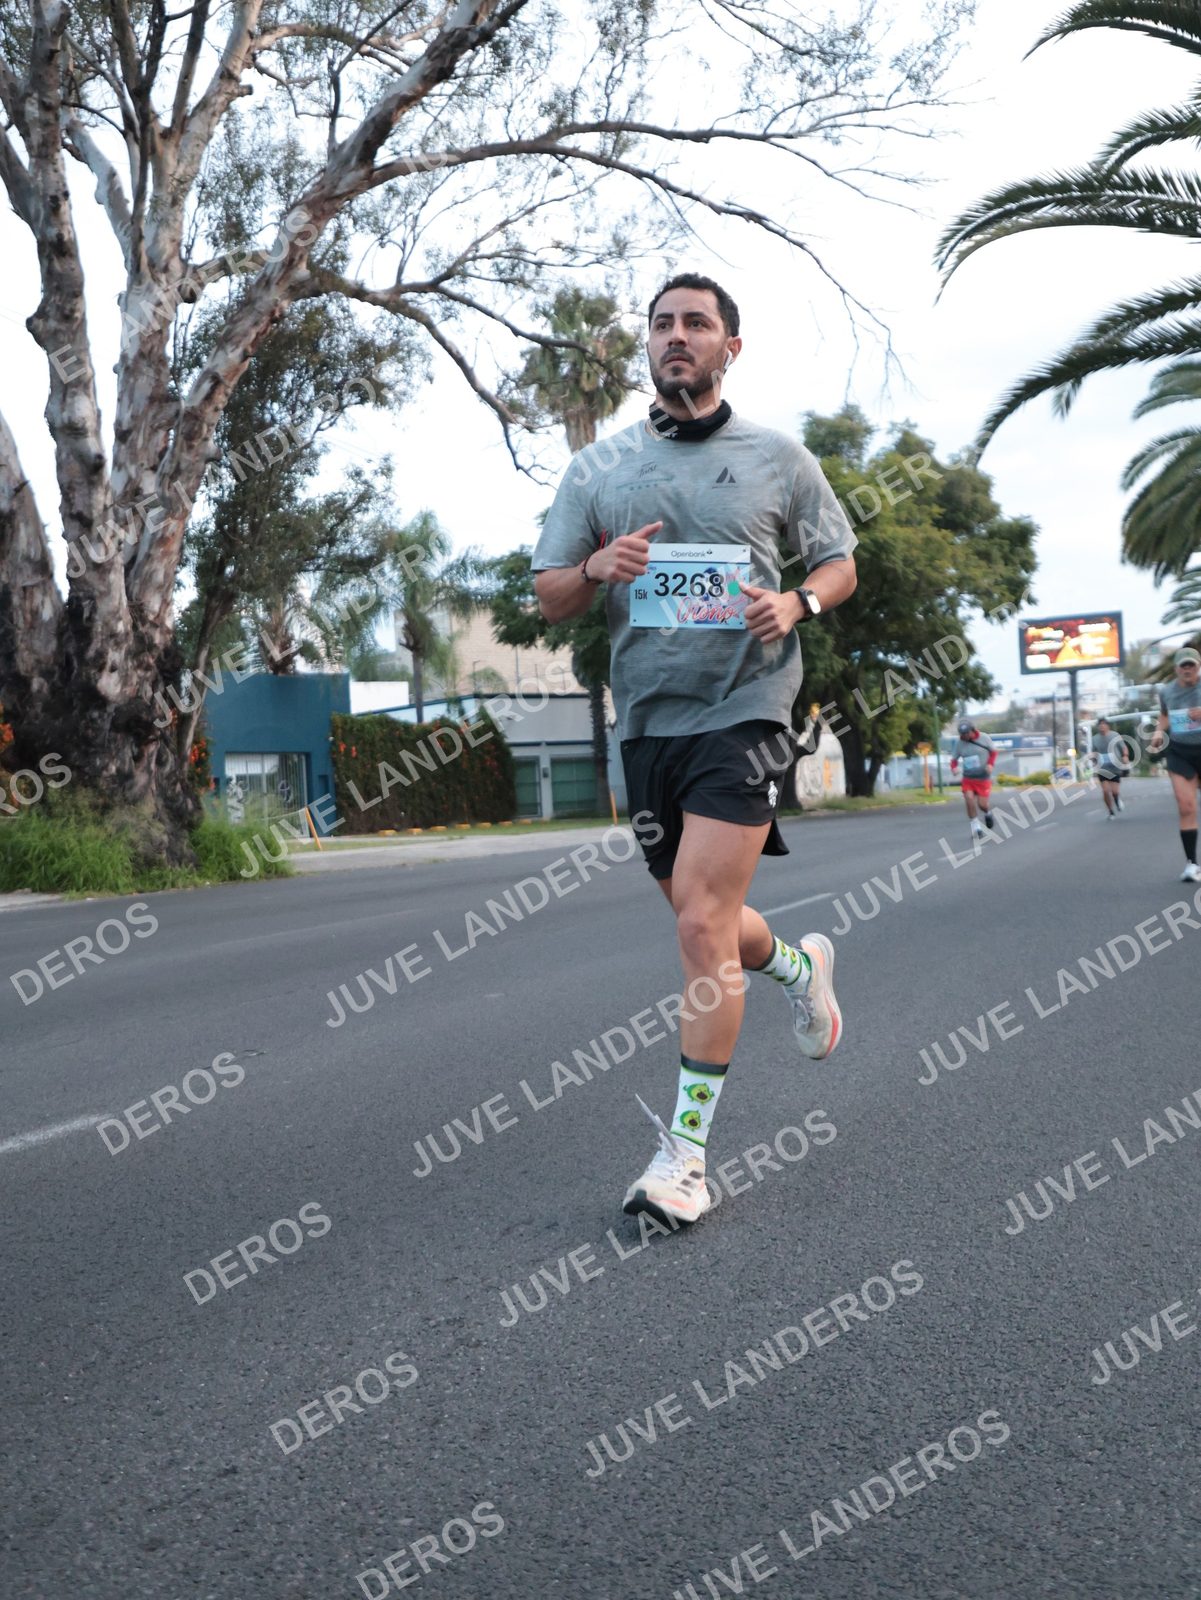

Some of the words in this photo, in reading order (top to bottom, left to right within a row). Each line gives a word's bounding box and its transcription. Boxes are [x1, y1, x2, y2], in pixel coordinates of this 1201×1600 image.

[670, 550, 706, 558] Openbank
[654, 572, 725, 598] 3268
[634, 589, 648, 600] 15k
